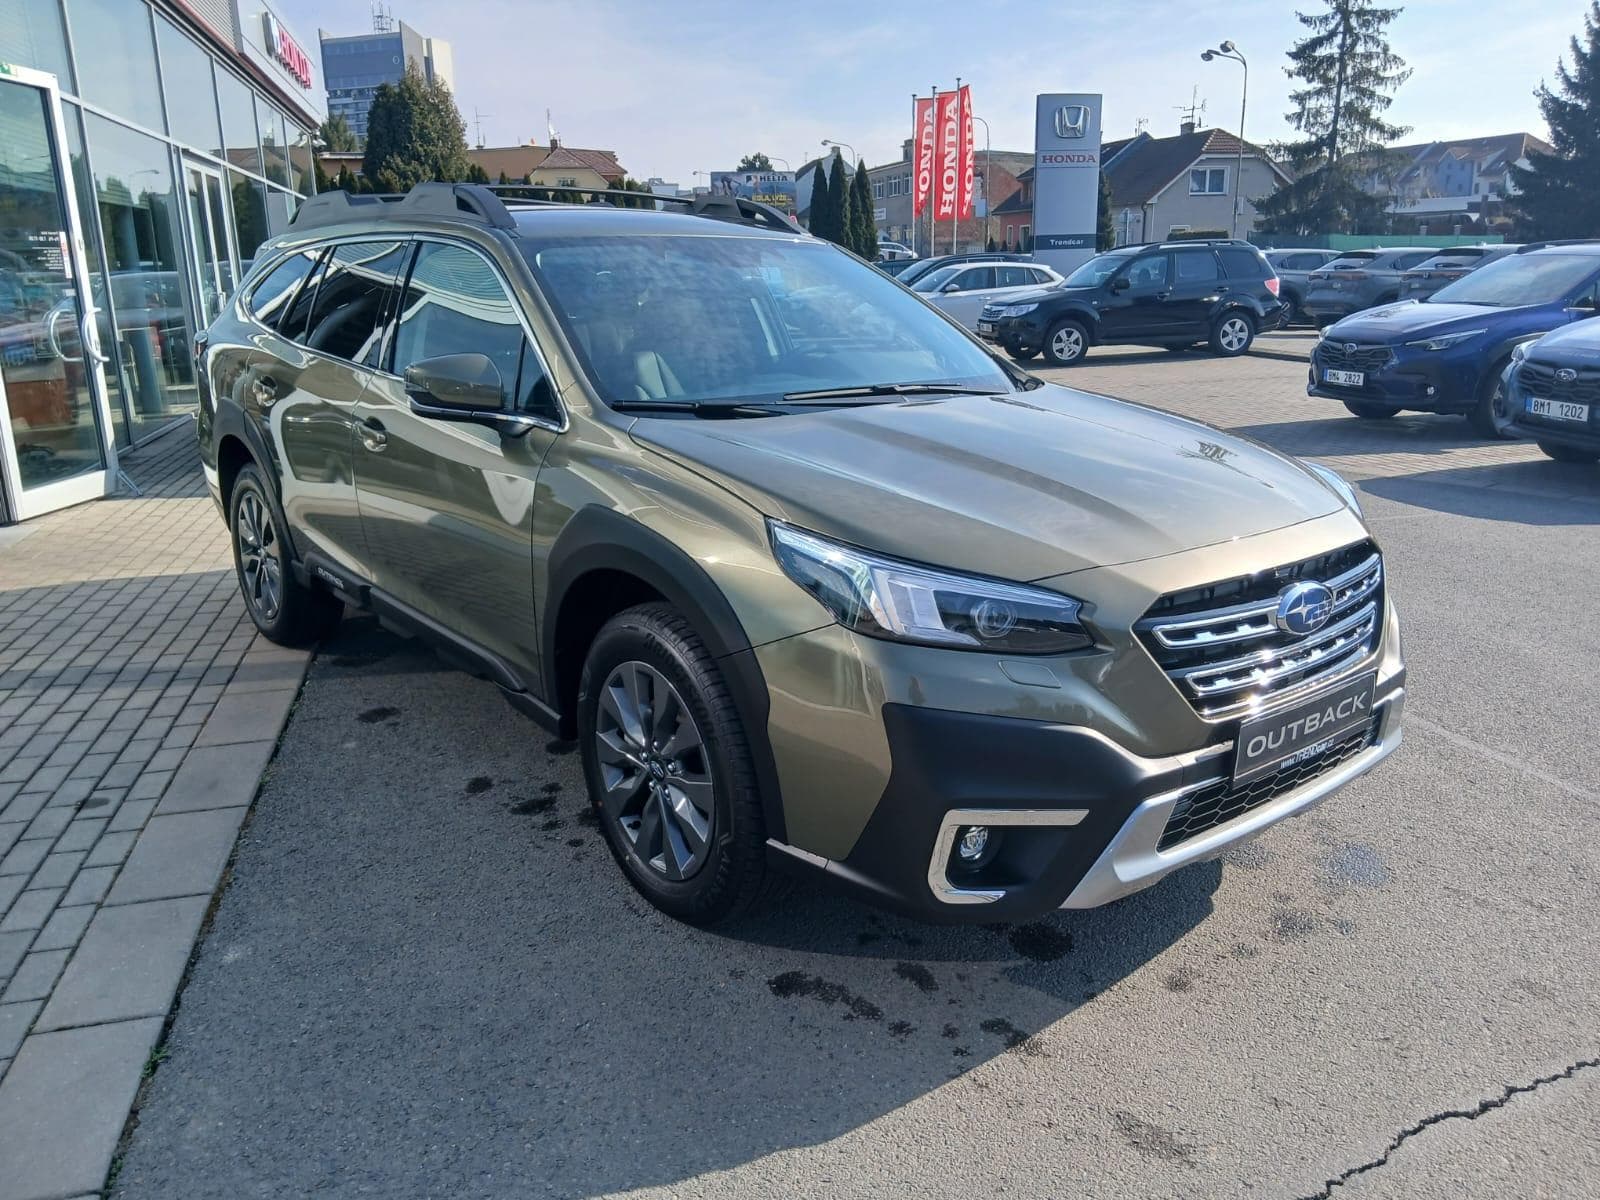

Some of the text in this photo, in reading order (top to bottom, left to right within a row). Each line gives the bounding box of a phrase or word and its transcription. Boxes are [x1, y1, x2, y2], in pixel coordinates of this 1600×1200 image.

[940, 95, 958, 216] HONDA
[1041, 154, 1097, 164] HONDA
[1049, 238, 1084, 246] Trendcar
[1343, 373, 1361, 384] 2822
[1533, 400, 1584, 419] 8M1 1202
[1246, 691, 1368, 758] OUTBACK
